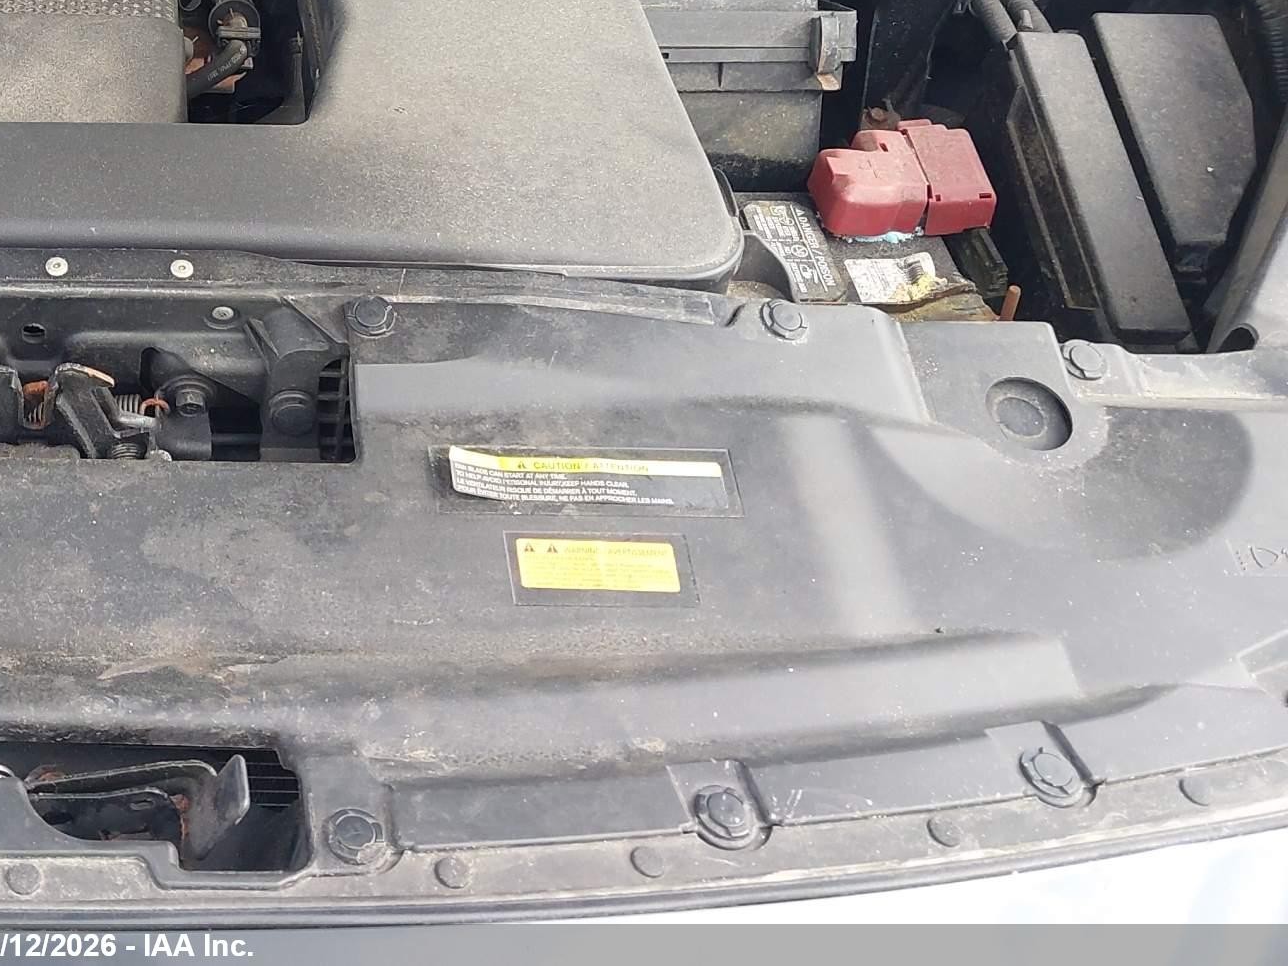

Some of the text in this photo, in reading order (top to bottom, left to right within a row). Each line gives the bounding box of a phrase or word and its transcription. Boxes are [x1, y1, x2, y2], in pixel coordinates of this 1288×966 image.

[798, 216, 820, 248] DANGER
[814, 255, 836, 286] POISON
[534, 462, 581, 470] CAUTION
